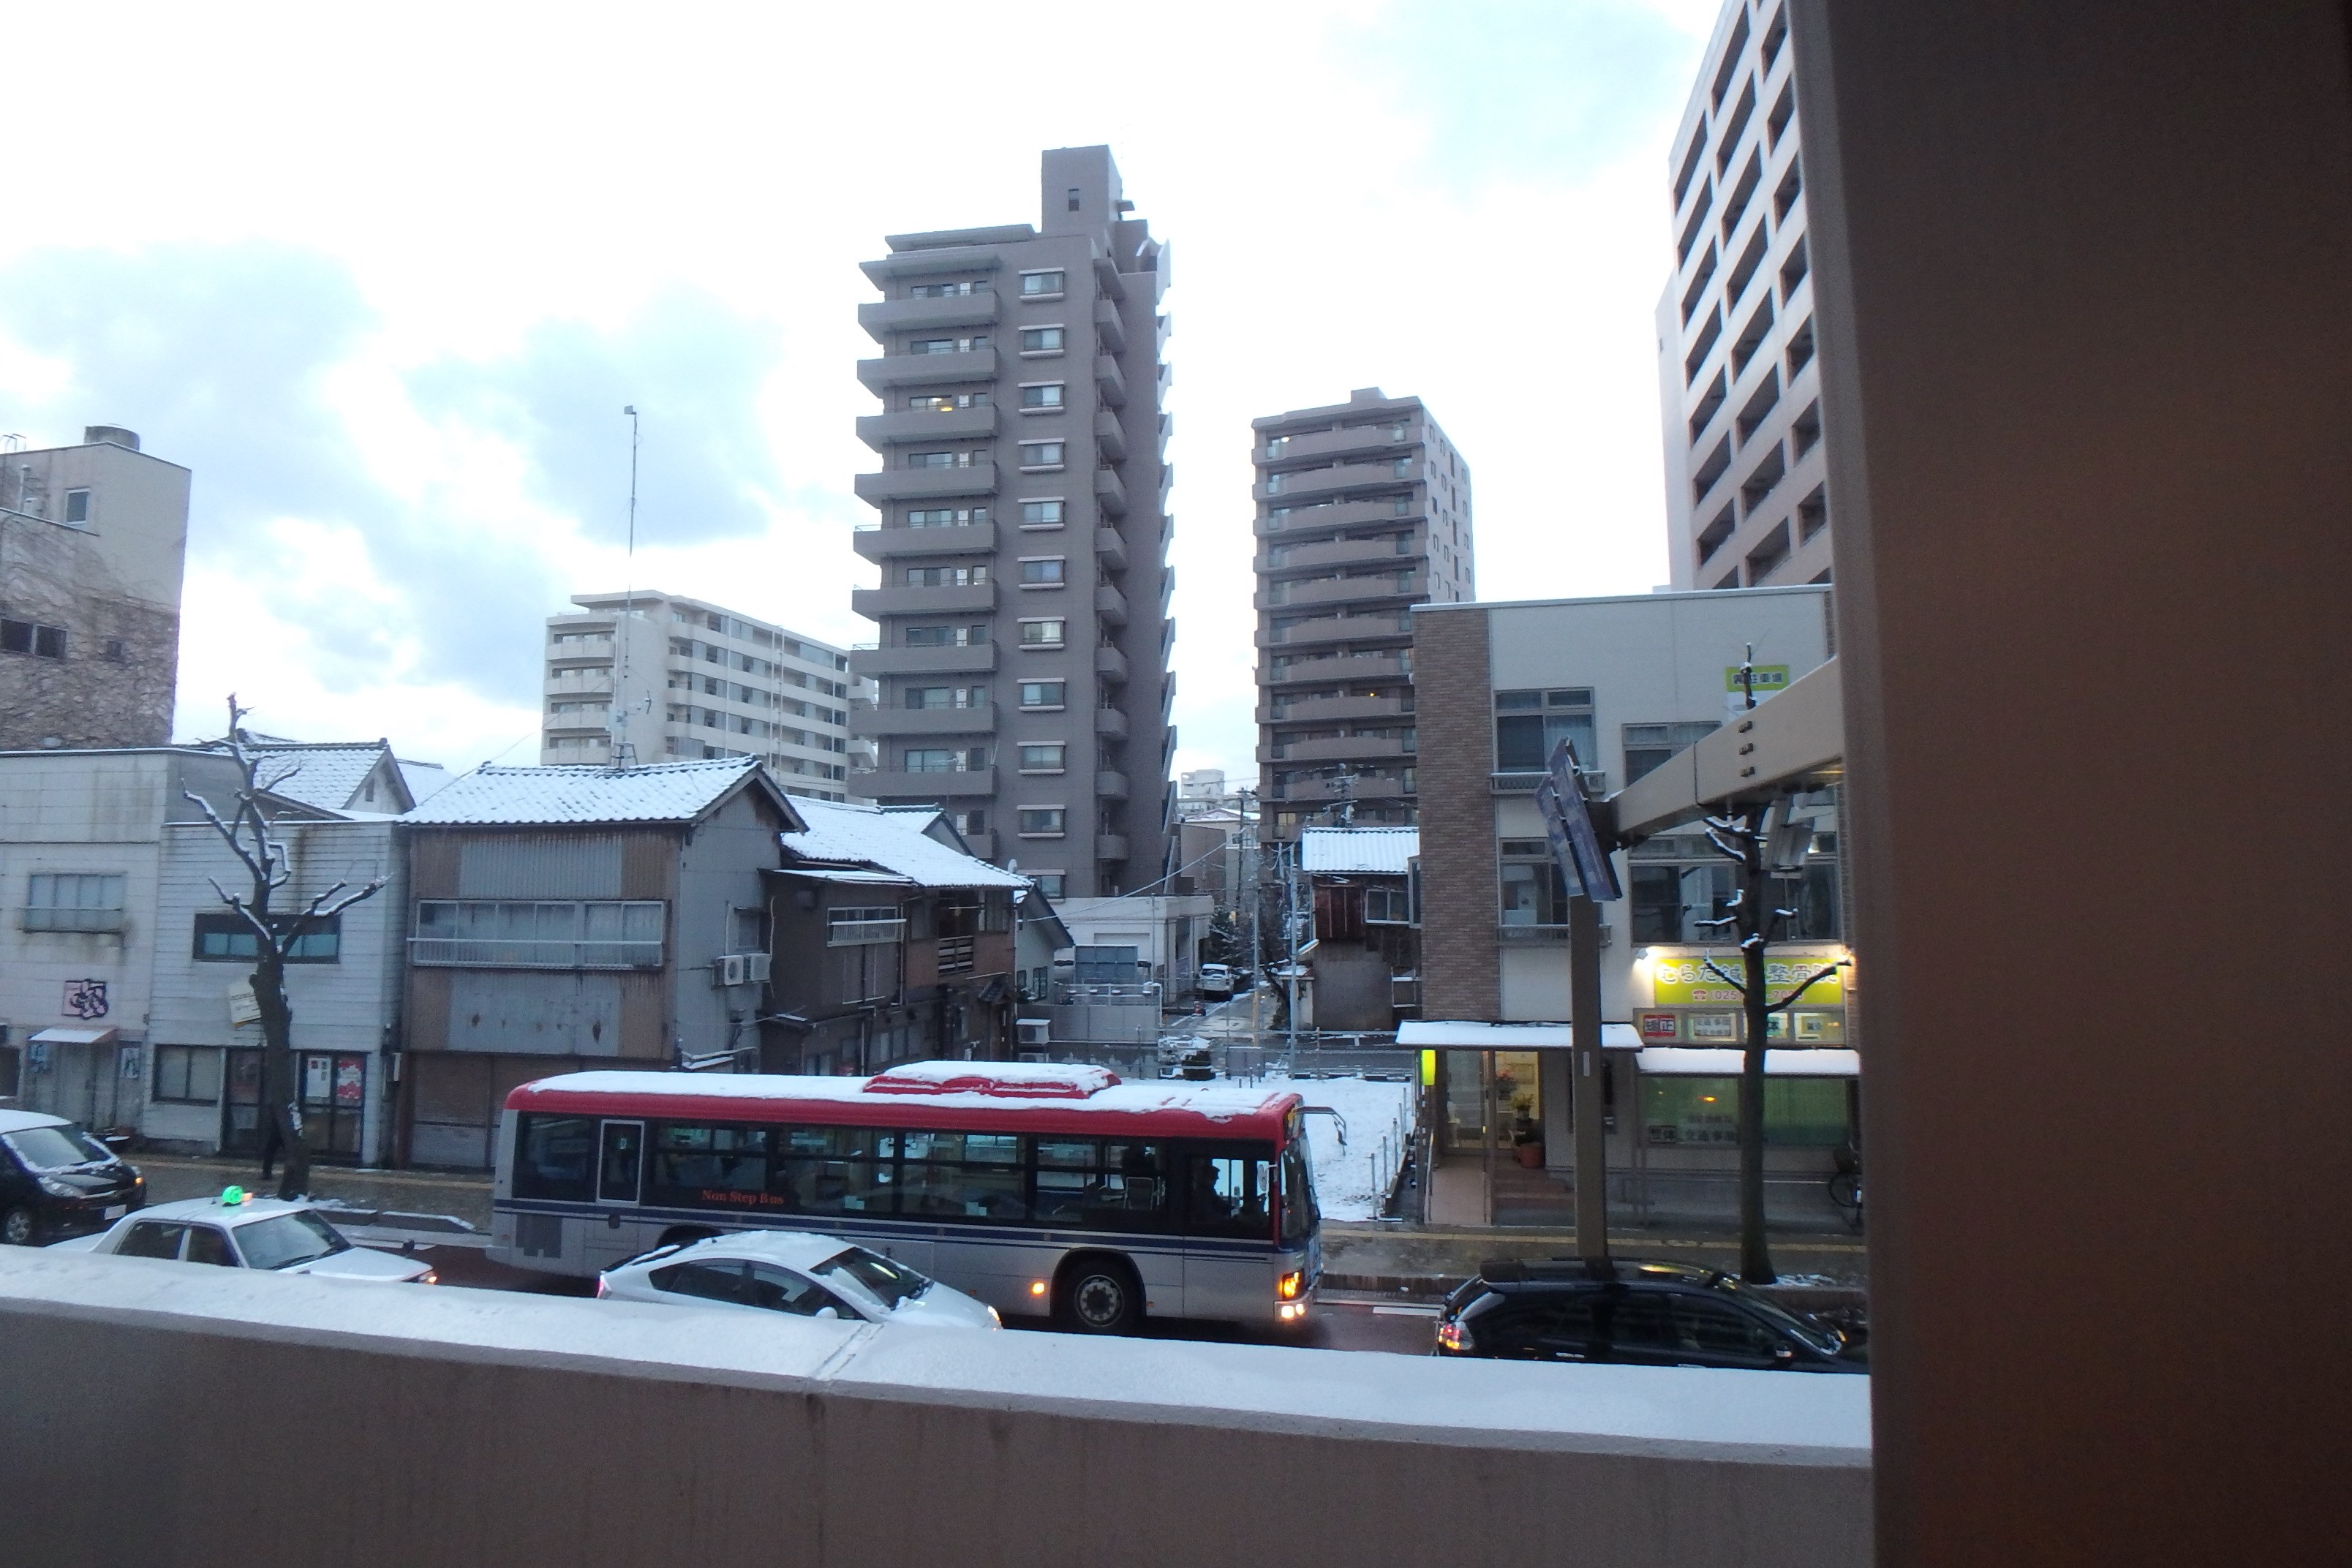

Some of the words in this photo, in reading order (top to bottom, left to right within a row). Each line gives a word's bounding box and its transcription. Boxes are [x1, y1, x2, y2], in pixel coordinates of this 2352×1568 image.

[703, 1189, 727, 1201] Non
[731, 1191, 756, 1205] Step
[760, 1193, 784, 1205] Bus
